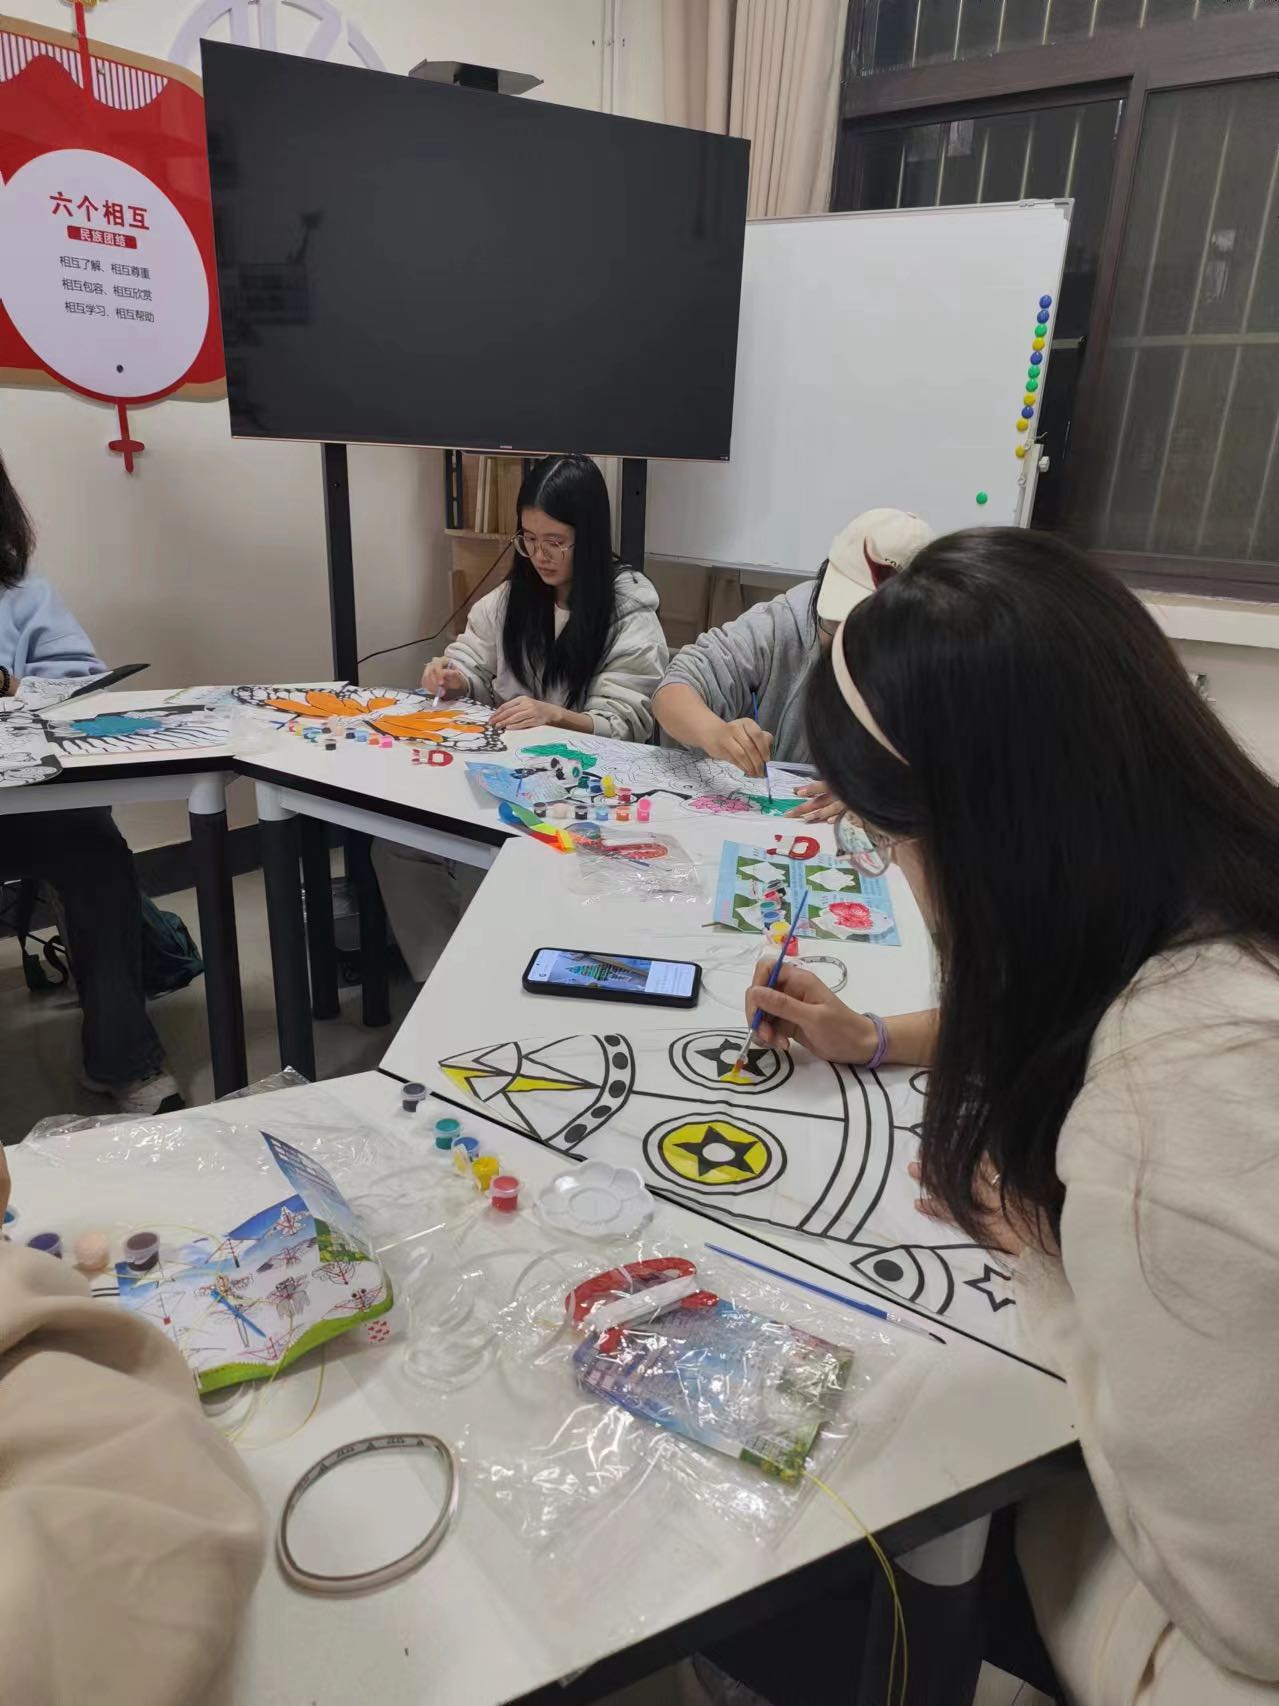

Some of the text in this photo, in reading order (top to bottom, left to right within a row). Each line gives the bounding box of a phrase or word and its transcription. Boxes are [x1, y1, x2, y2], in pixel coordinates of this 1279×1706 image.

[49, 191, 150, 230] 六个相互
[80, 228, 126, 247] 民族团结
